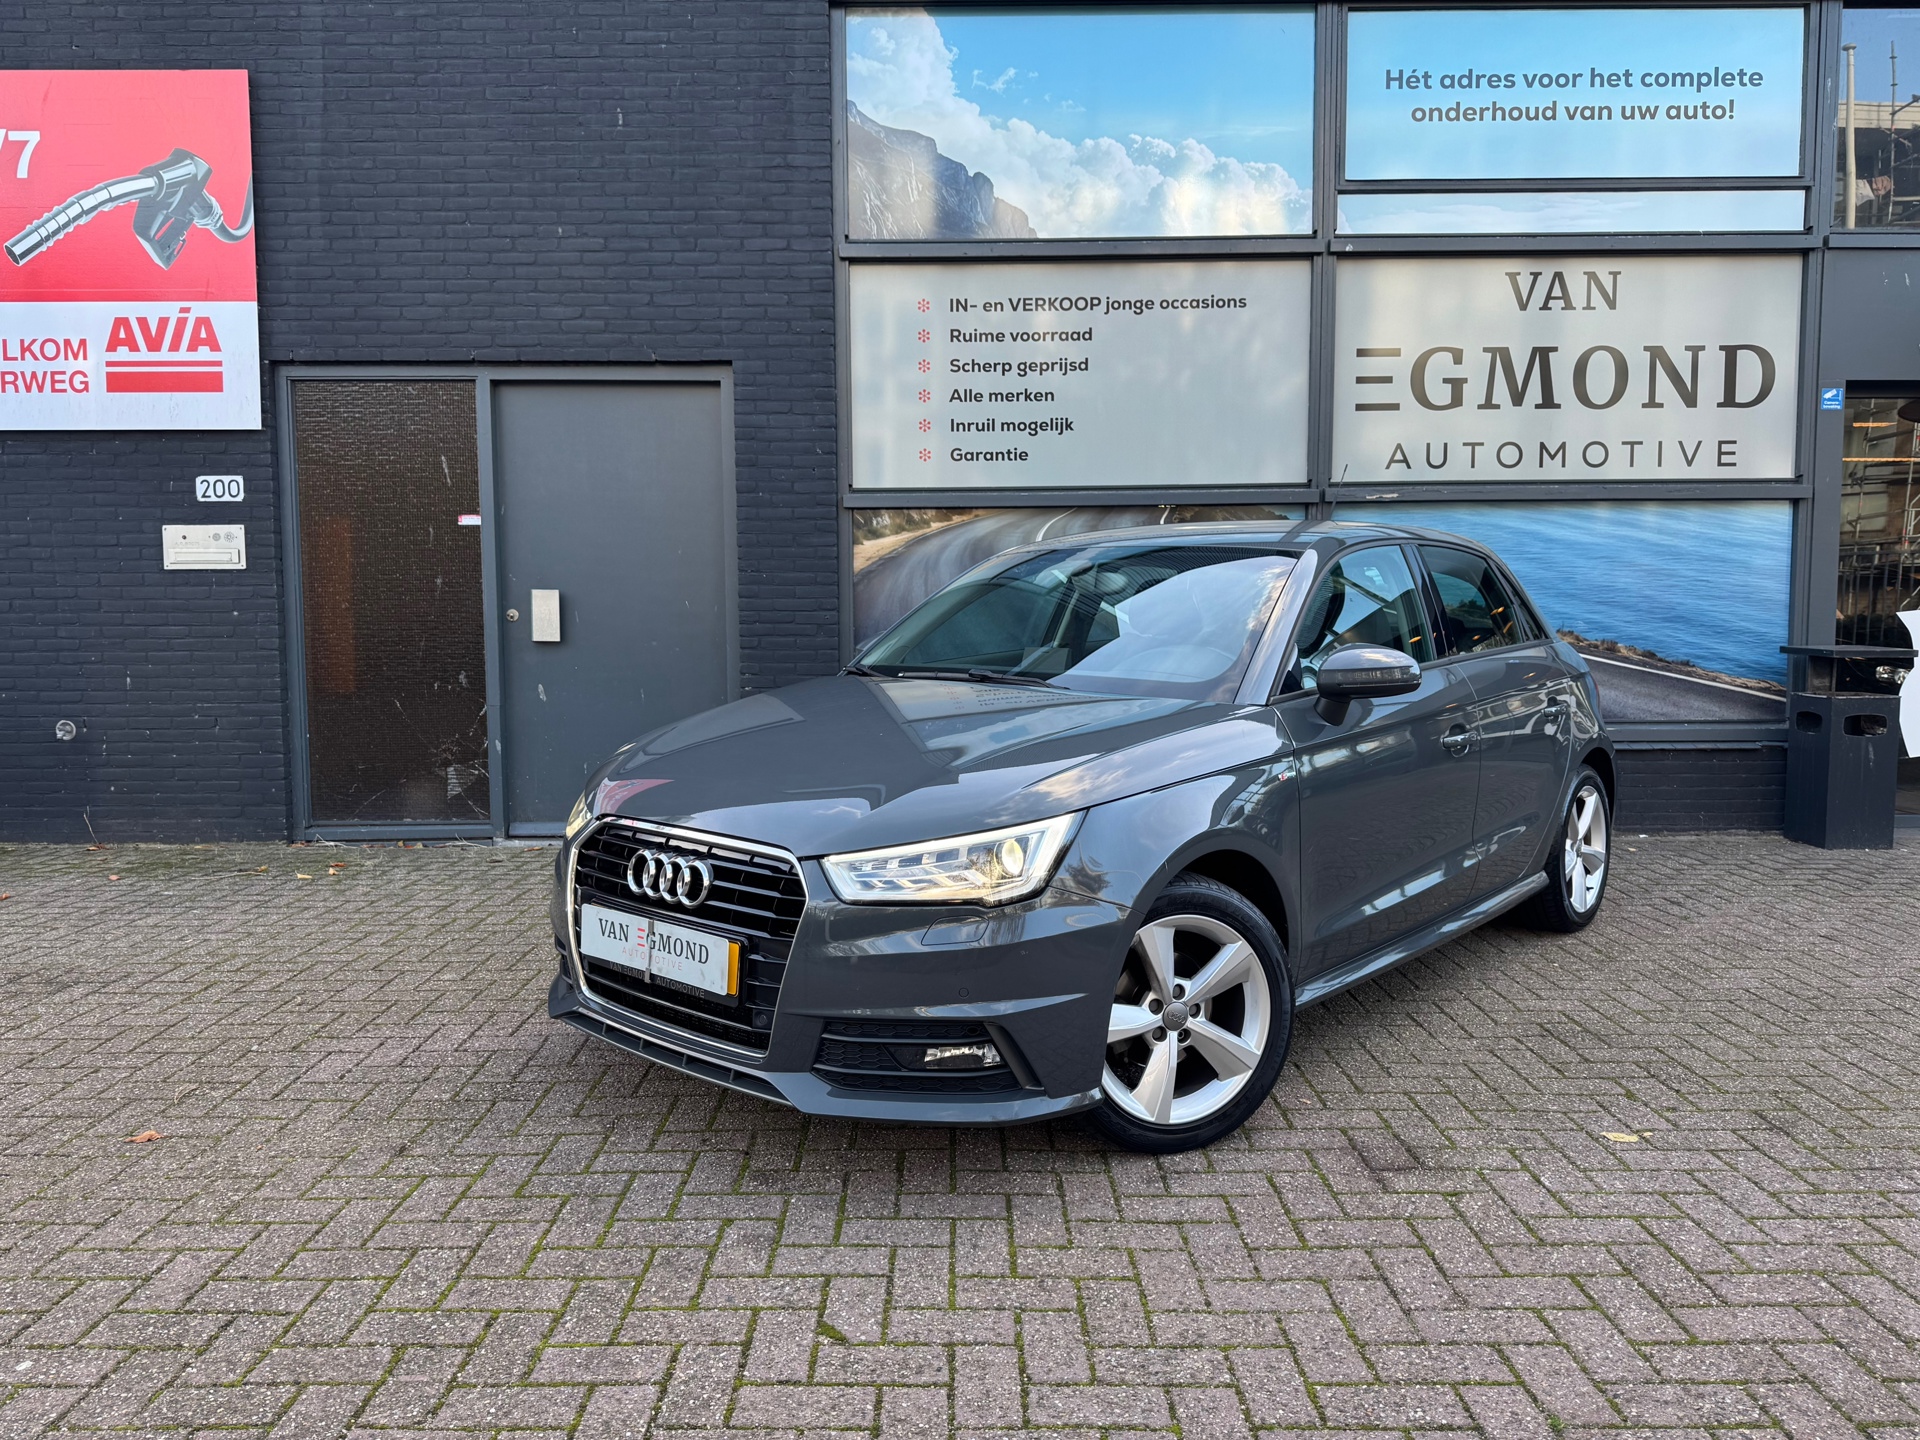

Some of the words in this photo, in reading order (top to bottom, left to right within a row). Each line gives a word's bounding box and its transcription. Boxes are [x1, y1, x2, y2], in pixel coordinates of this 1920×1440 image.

[1385, 69, 1432, 90] Hét
[1439, 68, 1516, 89] adres
[1522, 71, 1583, 89] voor
[1590, 67, 1633, 88] het
[1640, 66, 1764, 93] complete
[1411, 100, 1557, 122] onderhoud
[1564, 105, 1613, 121] van
[1621, 104, 1659, 120] uw
[1665, 99, 1735, 120] auto!
[1504, 271, 1622, 312] VAN
[949, 298, 978, 313] IN-
[982, 301, 1004, 312] en
[1008, 296, 1102, 312] VERKOOP
[1104, 296, 1155, 316] jonge
[1159, 294, 1247, 310] occasions
[949, 328, 1006, 342] Ruime
[1009, 327, 1093, 342] voorraad
[949, 358, 1013, 377] Scherp
[1016, 357, 1089, 378] geprijsd
[1355, 343, 1777, 412] EGMOND
[949, 388, 984, 403] Alle
[988, 388, 1055, 402] merken
[950, 418, 996, 433] Inruil
[1000, 417, 1074, 437] mogelijk
[950, 447, 1029, 462] Garantie
[1384, 440, 1738, 470] AUTOMOTIVE
[200, 479, 240, 499] 200
[598, 917, 630, 943] VAN
[609, 961, 622, 973] VAN
[656, 976, 705, 999] AUTOMOTIVE
